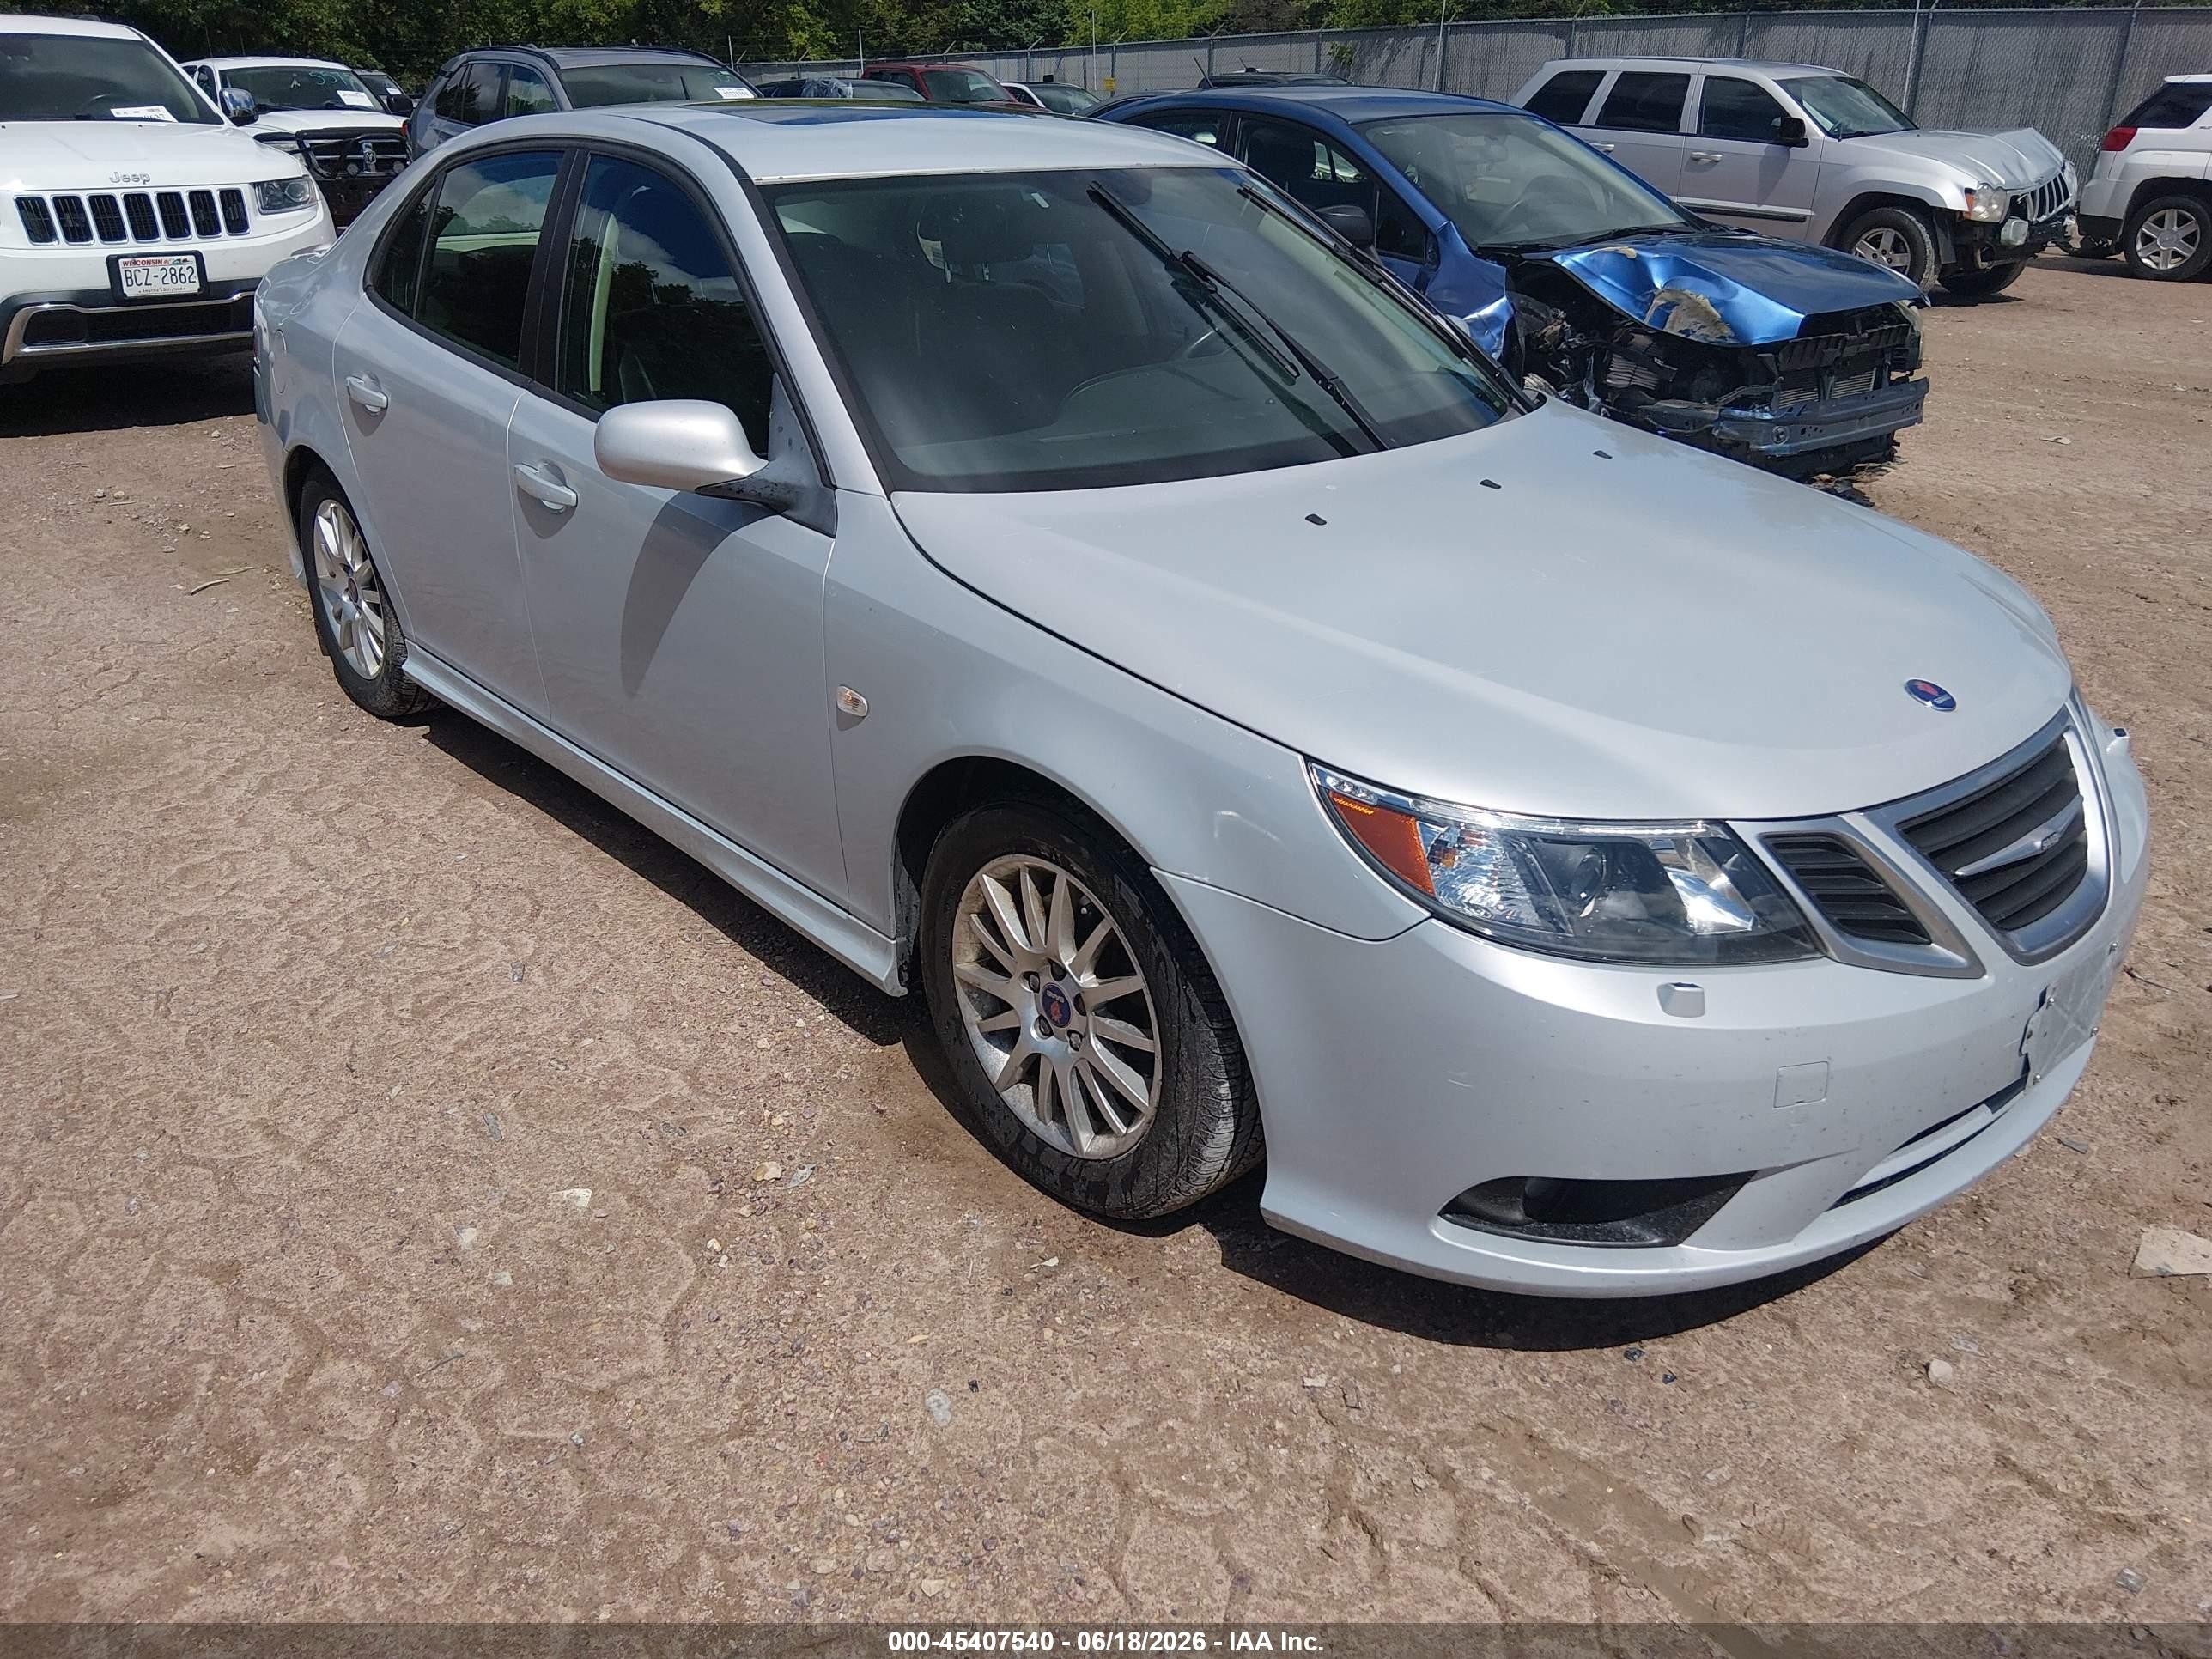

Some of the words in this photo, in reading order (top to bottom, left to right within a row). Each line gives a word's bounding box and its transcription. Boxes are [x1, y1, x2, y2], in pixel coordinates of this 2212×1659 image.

[109, 171, 151, 185] Jeep
[122, 258, 163, 267] WISCONSIN
[124, 265, 197, 288] BCZ-2862
